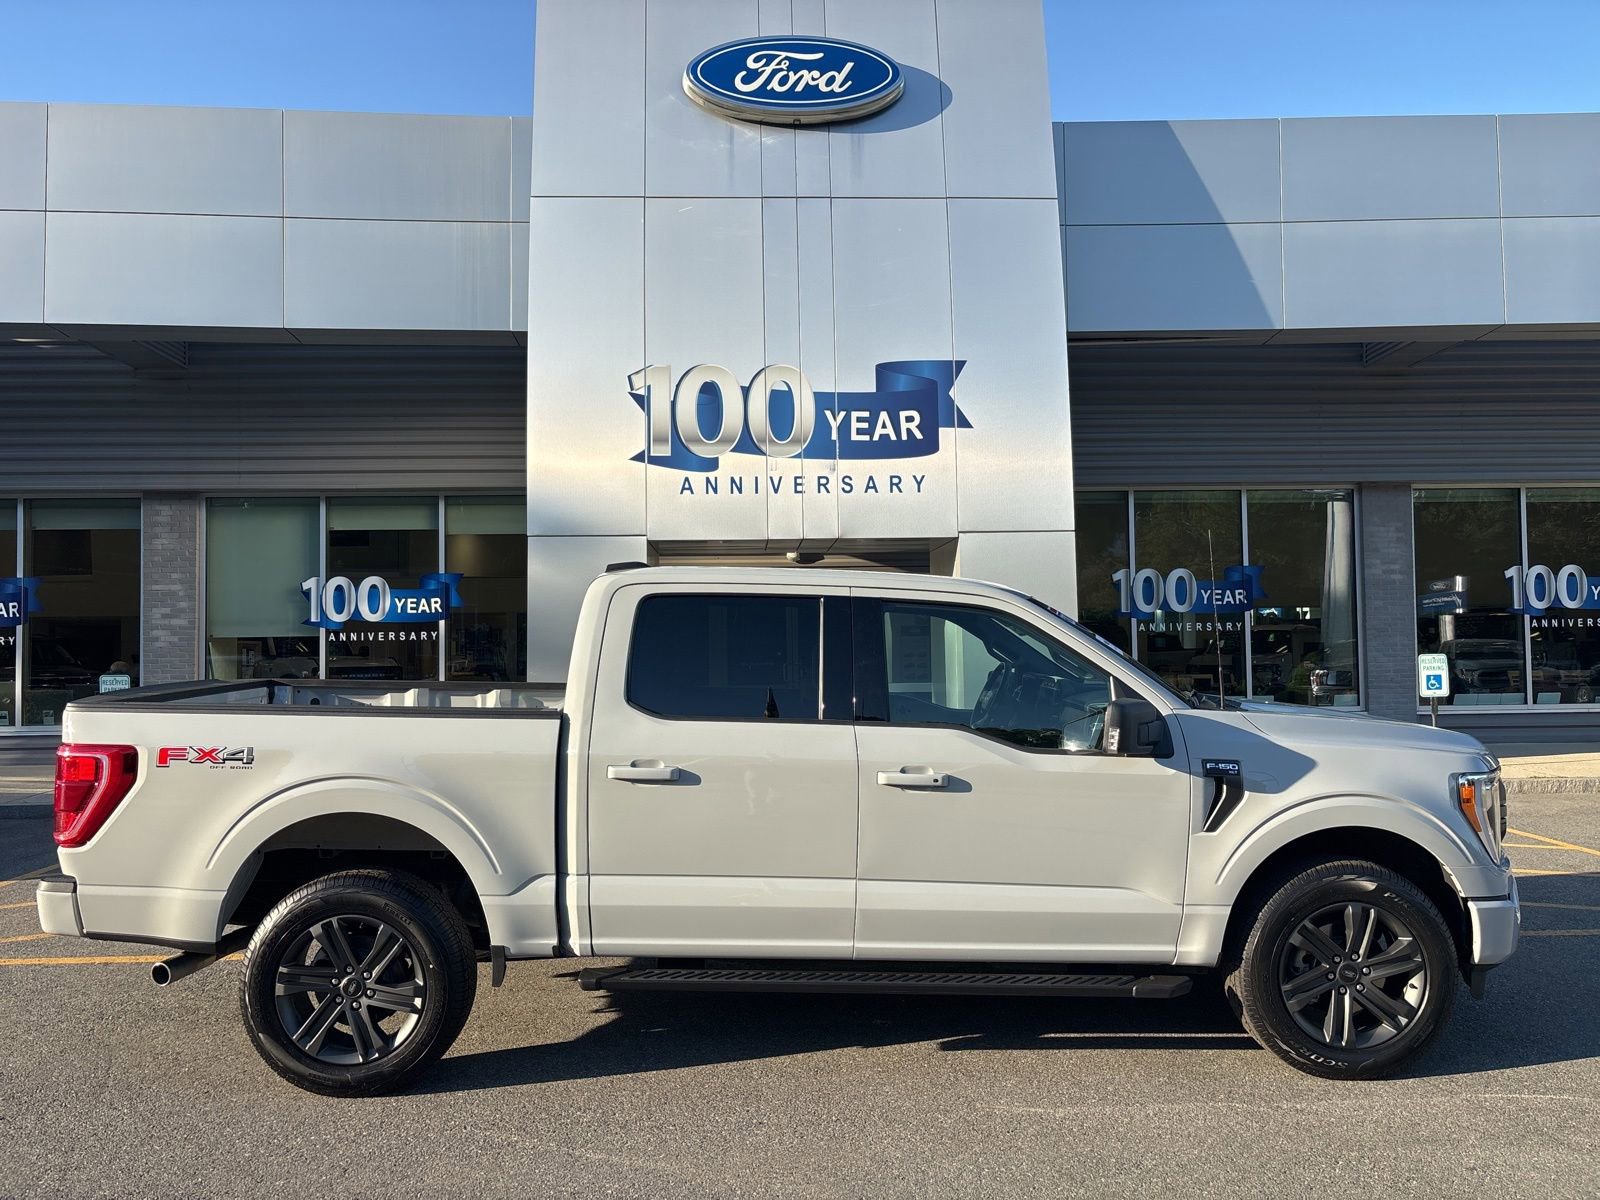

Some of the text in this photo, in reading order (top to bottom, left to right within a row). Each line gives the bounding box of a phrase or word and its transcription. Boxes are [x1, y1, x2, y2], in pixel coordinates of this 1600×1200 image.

[734, 49, 855, 94] Ford
[629, 363, 924, 459] 100 YEAR
[679, 474, 927, 496] ANNIVERSARY
[301, 575, 443, 622] 100 YEAR
[1111, 567, 1248, 613] 100 YEAR
[1504, 564, 1588, 610] 100
[328, 630, 438, 642] ANNIVERSARY
[1138, 621, 1243, 632] ANNIVERSARY
[156, 746, 255, 768] FX4
[1206, 762, 1239, 770] F-150
